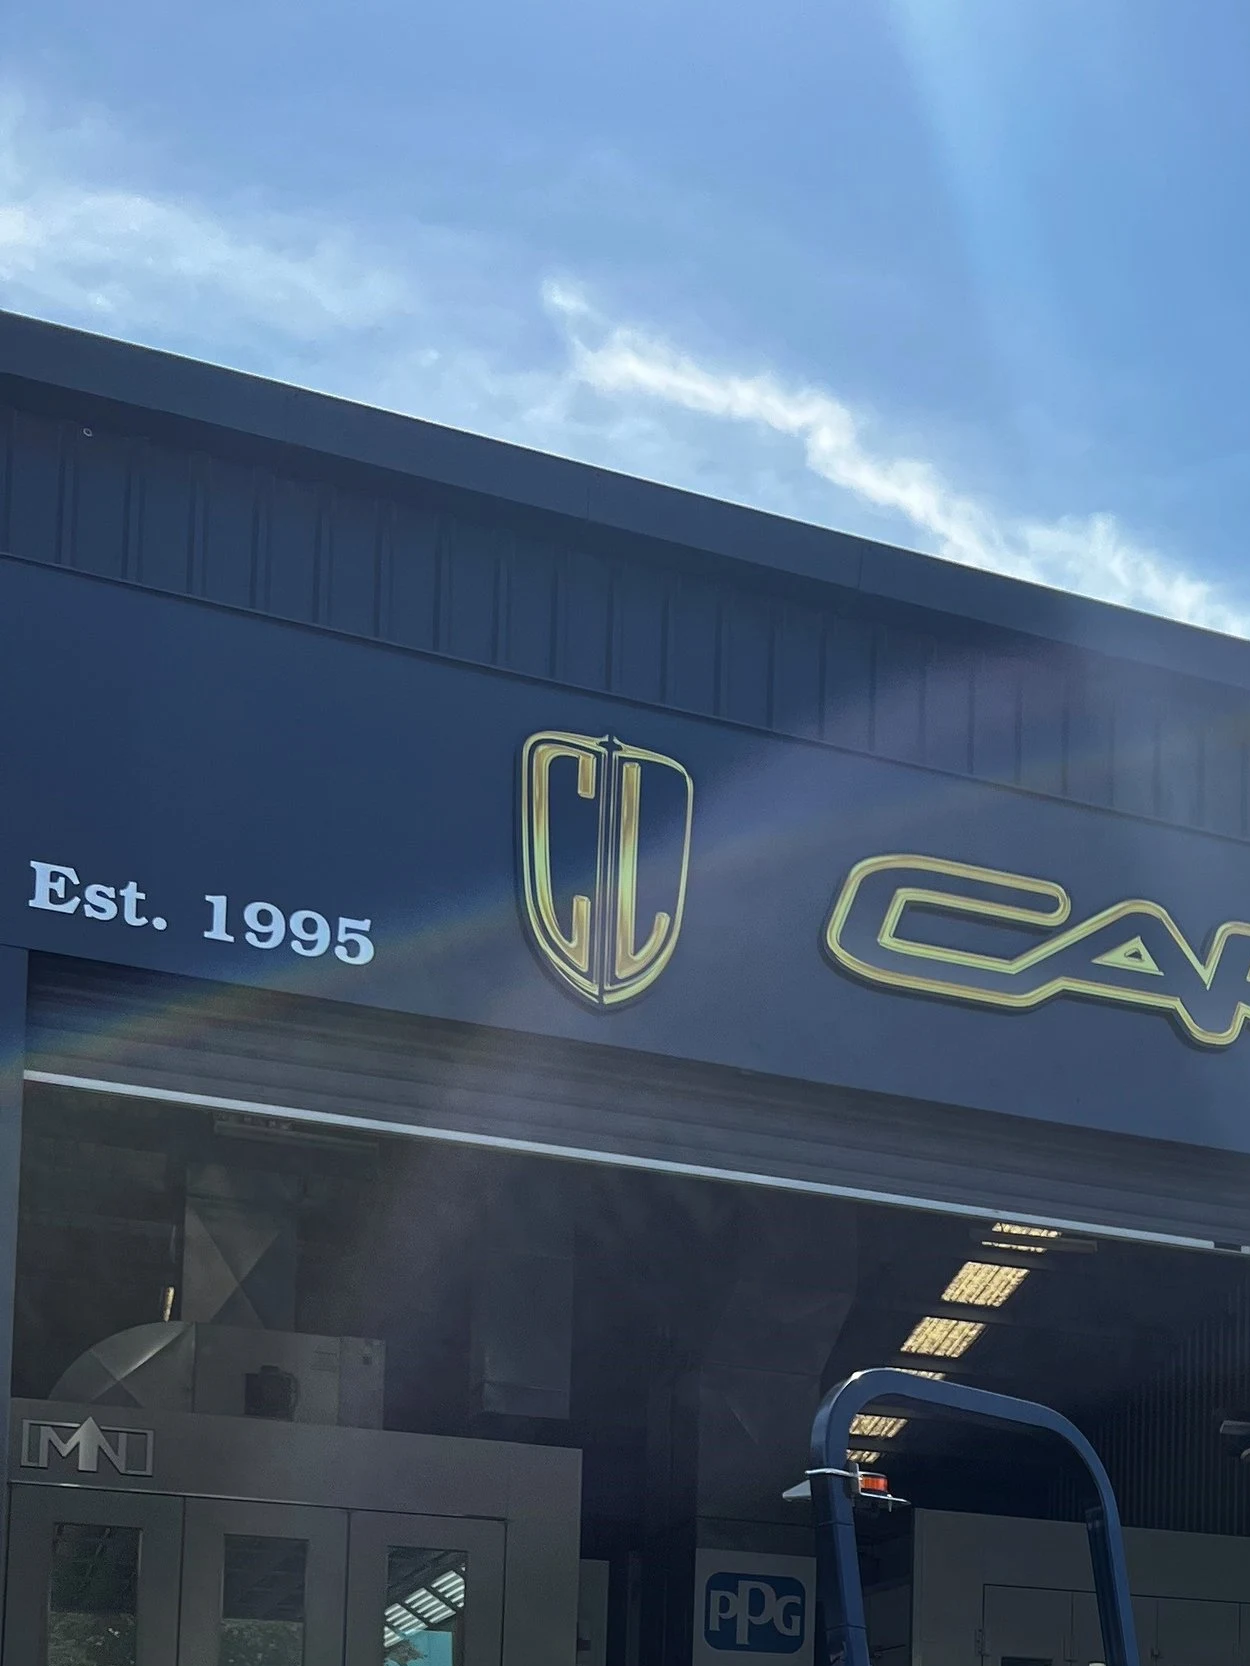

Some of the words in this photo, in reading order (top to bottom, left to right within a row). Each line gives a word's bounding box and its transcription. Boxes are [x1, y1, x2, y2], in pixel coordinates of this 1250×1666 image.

[28, 860, 168, 932] Est.
[203, 894, 375, 965] 1995
[709, 1580, 801, 1645] PPG
